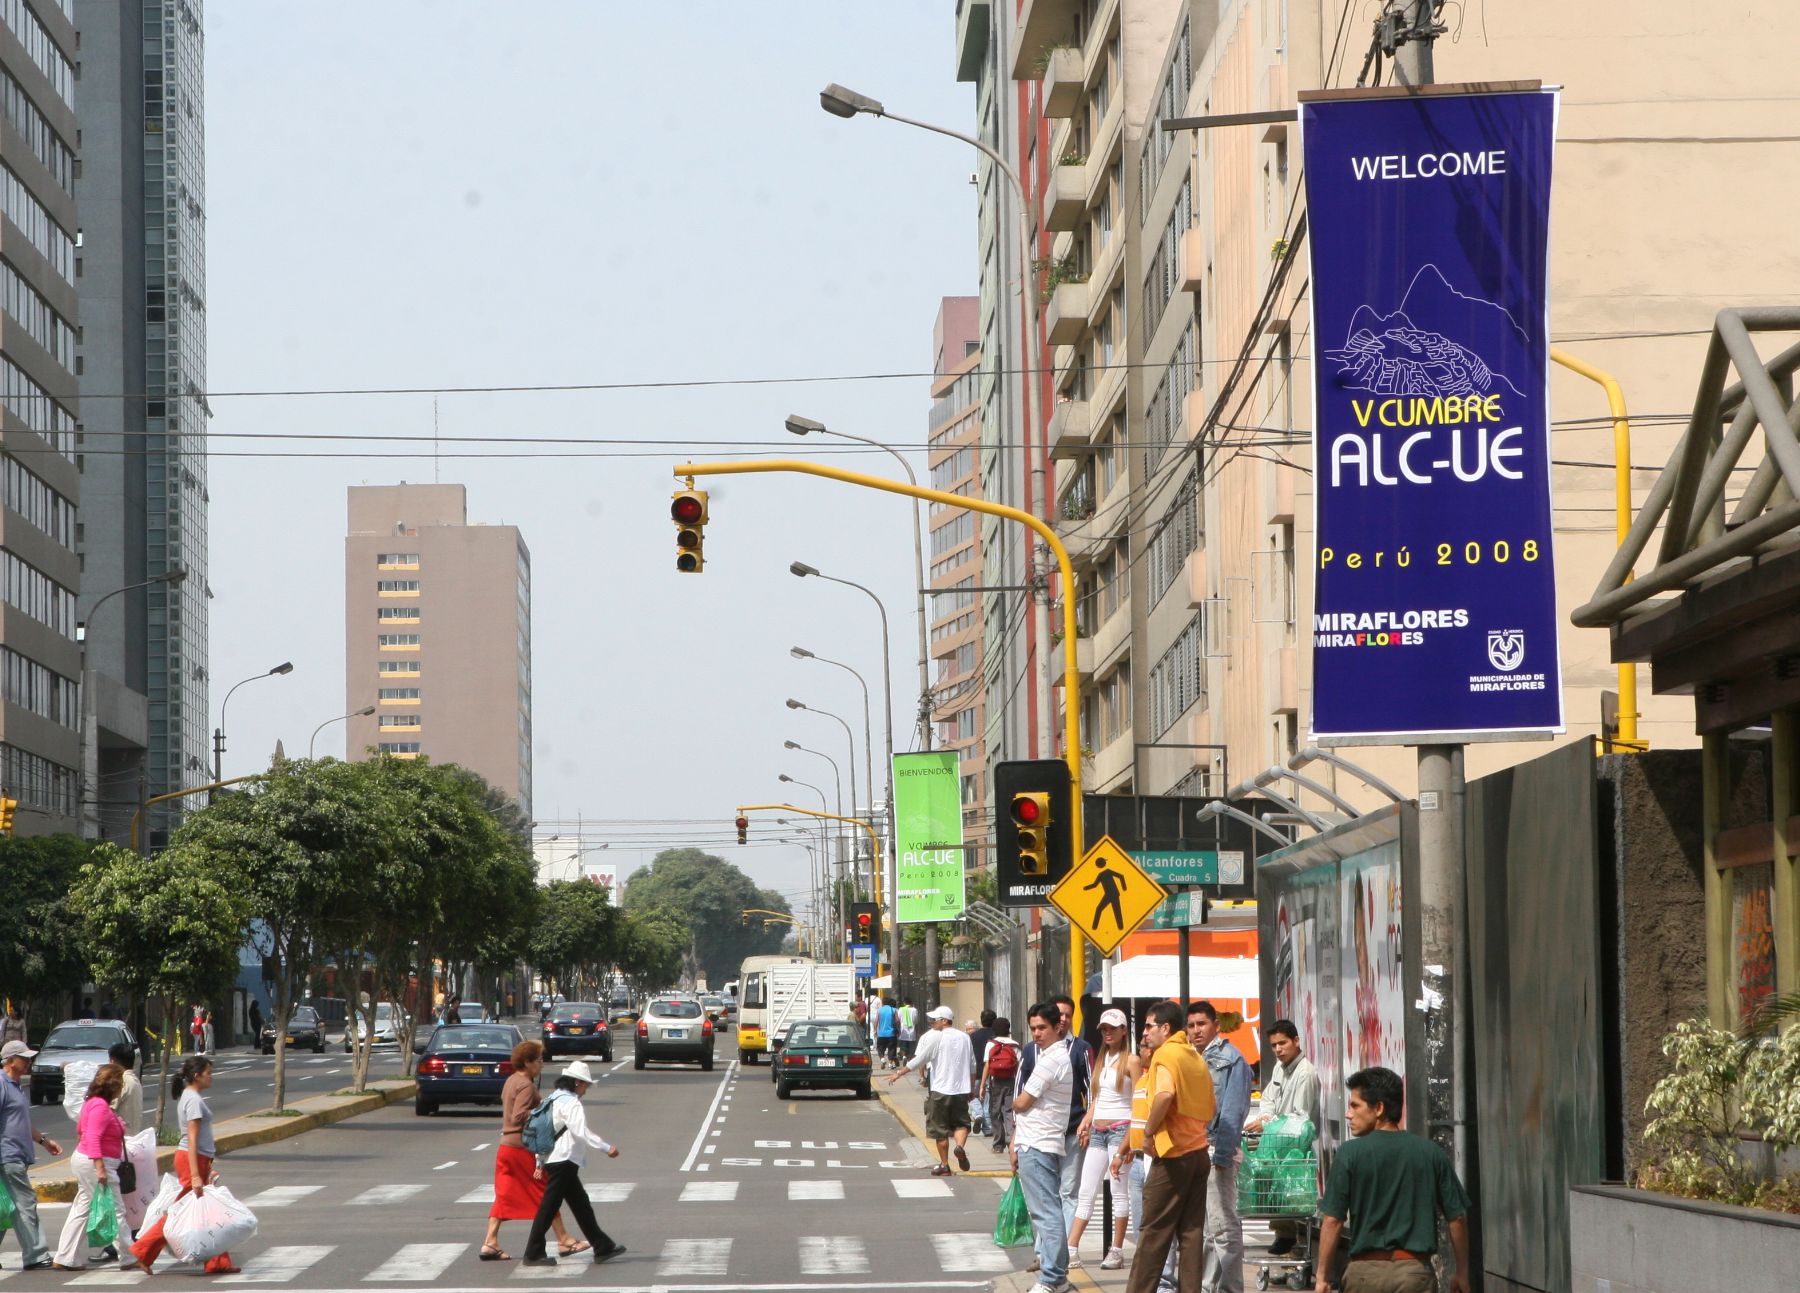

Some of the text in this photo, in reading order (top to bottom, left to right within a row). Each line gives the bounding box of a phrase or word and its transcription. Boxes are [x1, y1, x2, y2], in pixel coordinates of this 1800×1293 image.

[1351, 150, 1507, 181] WELCOME
[1352, 394, 1501, 427] V CUMBRE
[1331, 427, 1524, 487] ALC-UE
[1320, 540, 1540, 569] Perú 2008
[1314, 608, 1470, 632] MIRAFLORES
[1314, 631, 1424, 648] MIRAFLORES
[1469, 673, 1545, 683] MUNICIPALIDAD DE
[1470, 681, 1546, 692] MIRAFLORES
[899, 767, 954, 777] BIENVENIDOS
[903, 850, 955, 866] ALC-UE
[1134, 855, 1203, 867] Alcanfores
[1168, 873, 1211, 882] Cuadra 5
[754, 1140, 888, 1149] BUS
